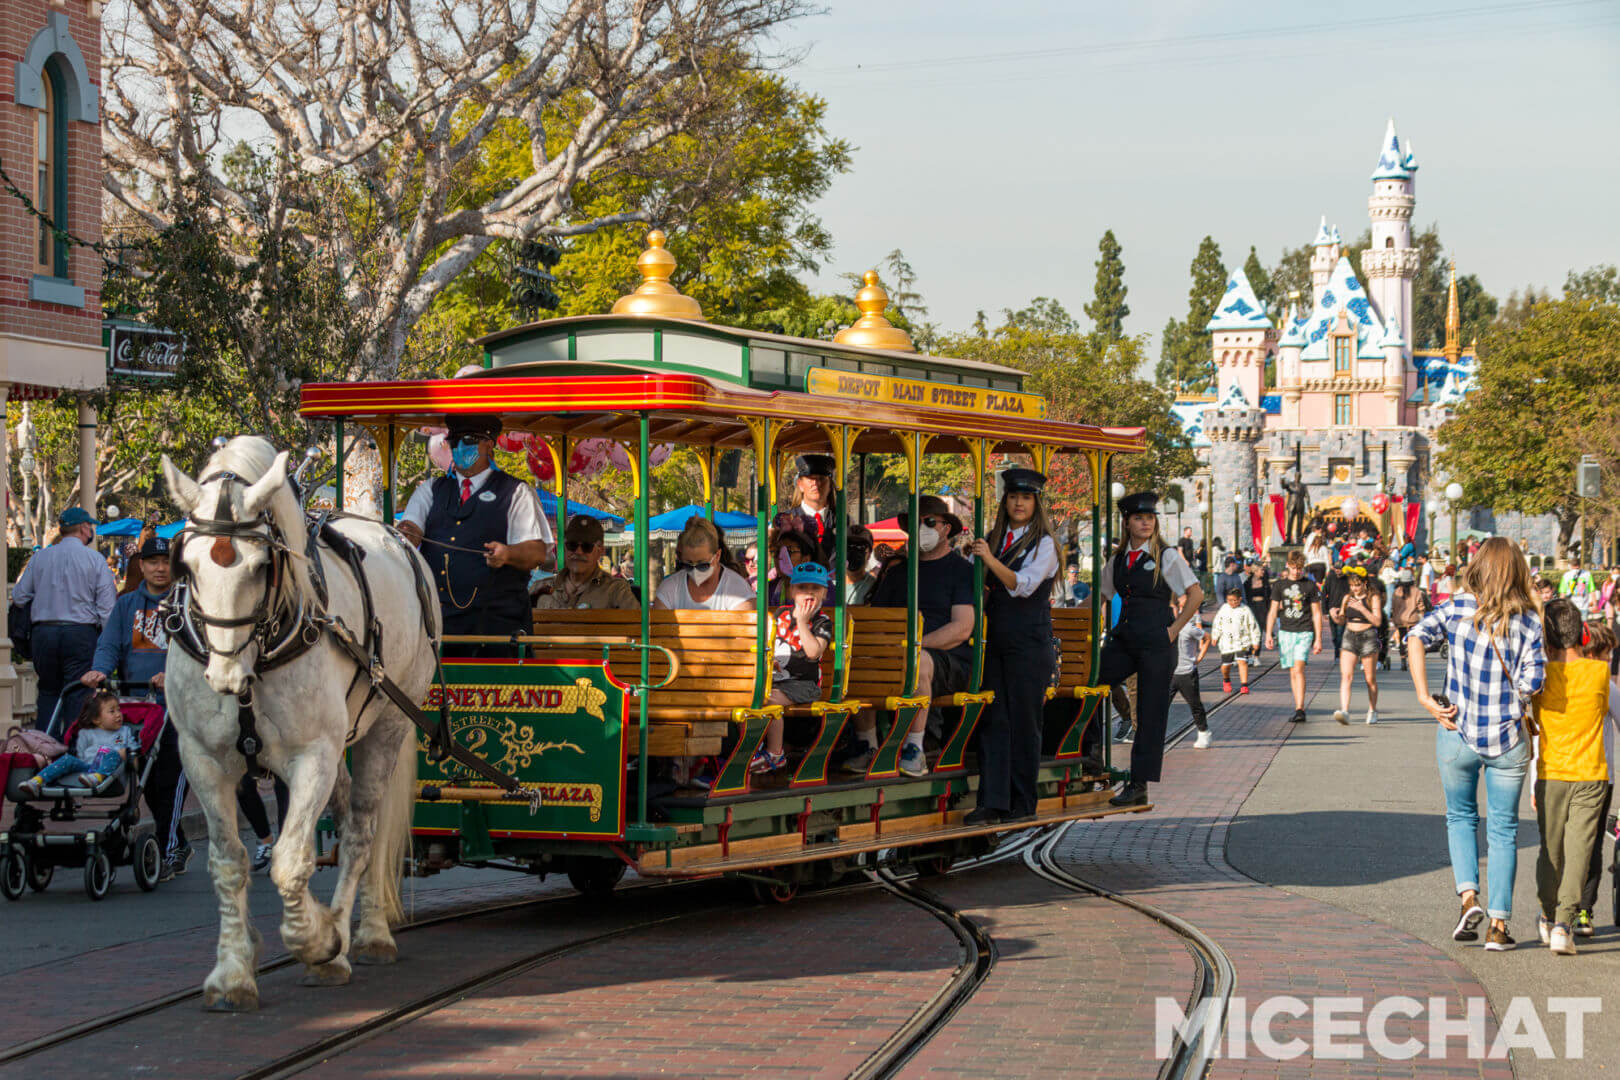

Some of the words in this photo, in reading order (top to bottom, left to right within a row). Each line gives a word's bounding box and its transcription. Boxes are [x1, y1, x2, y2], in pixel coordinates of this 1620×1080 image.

[838, 375, 881, 397] DEPOT
[892, 383, 925, 402] MAIN
[931, 387, 977, 409] STREET
[986, 393, 1025, 414] PLAZA
[466, 728, 489, 760] 2
